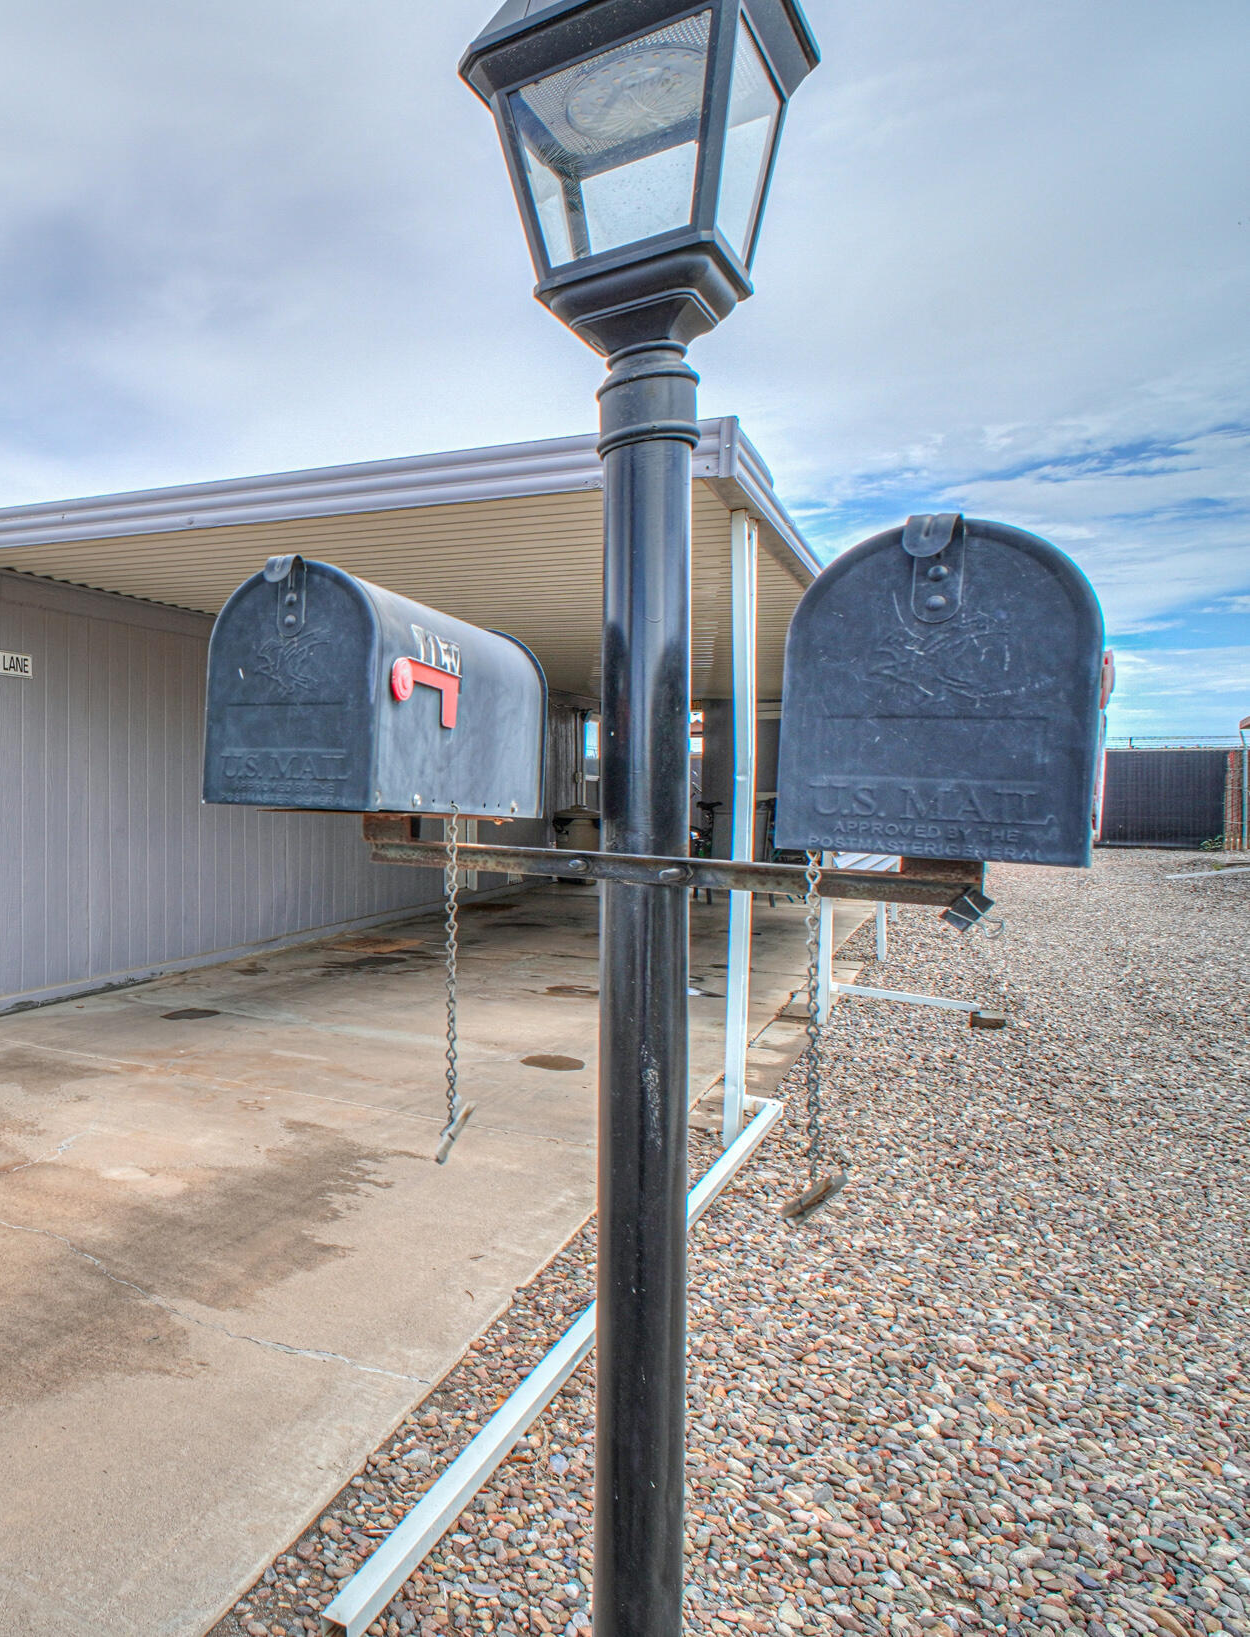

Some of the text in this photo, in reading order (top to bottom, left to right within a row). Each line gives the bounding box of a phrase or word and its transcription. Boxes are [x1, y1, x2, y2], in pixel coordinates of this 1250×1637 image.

[3, 654, 29, 673] LANE
[220, 754, 350, 781] U.S. MAIL
[808, 781, 1055, 826] U.S. MAIL
[832, 820, 1023, 843] APPROVED BY THE
[807, 835, 1044, 863] POSTMASTER GENERAL
